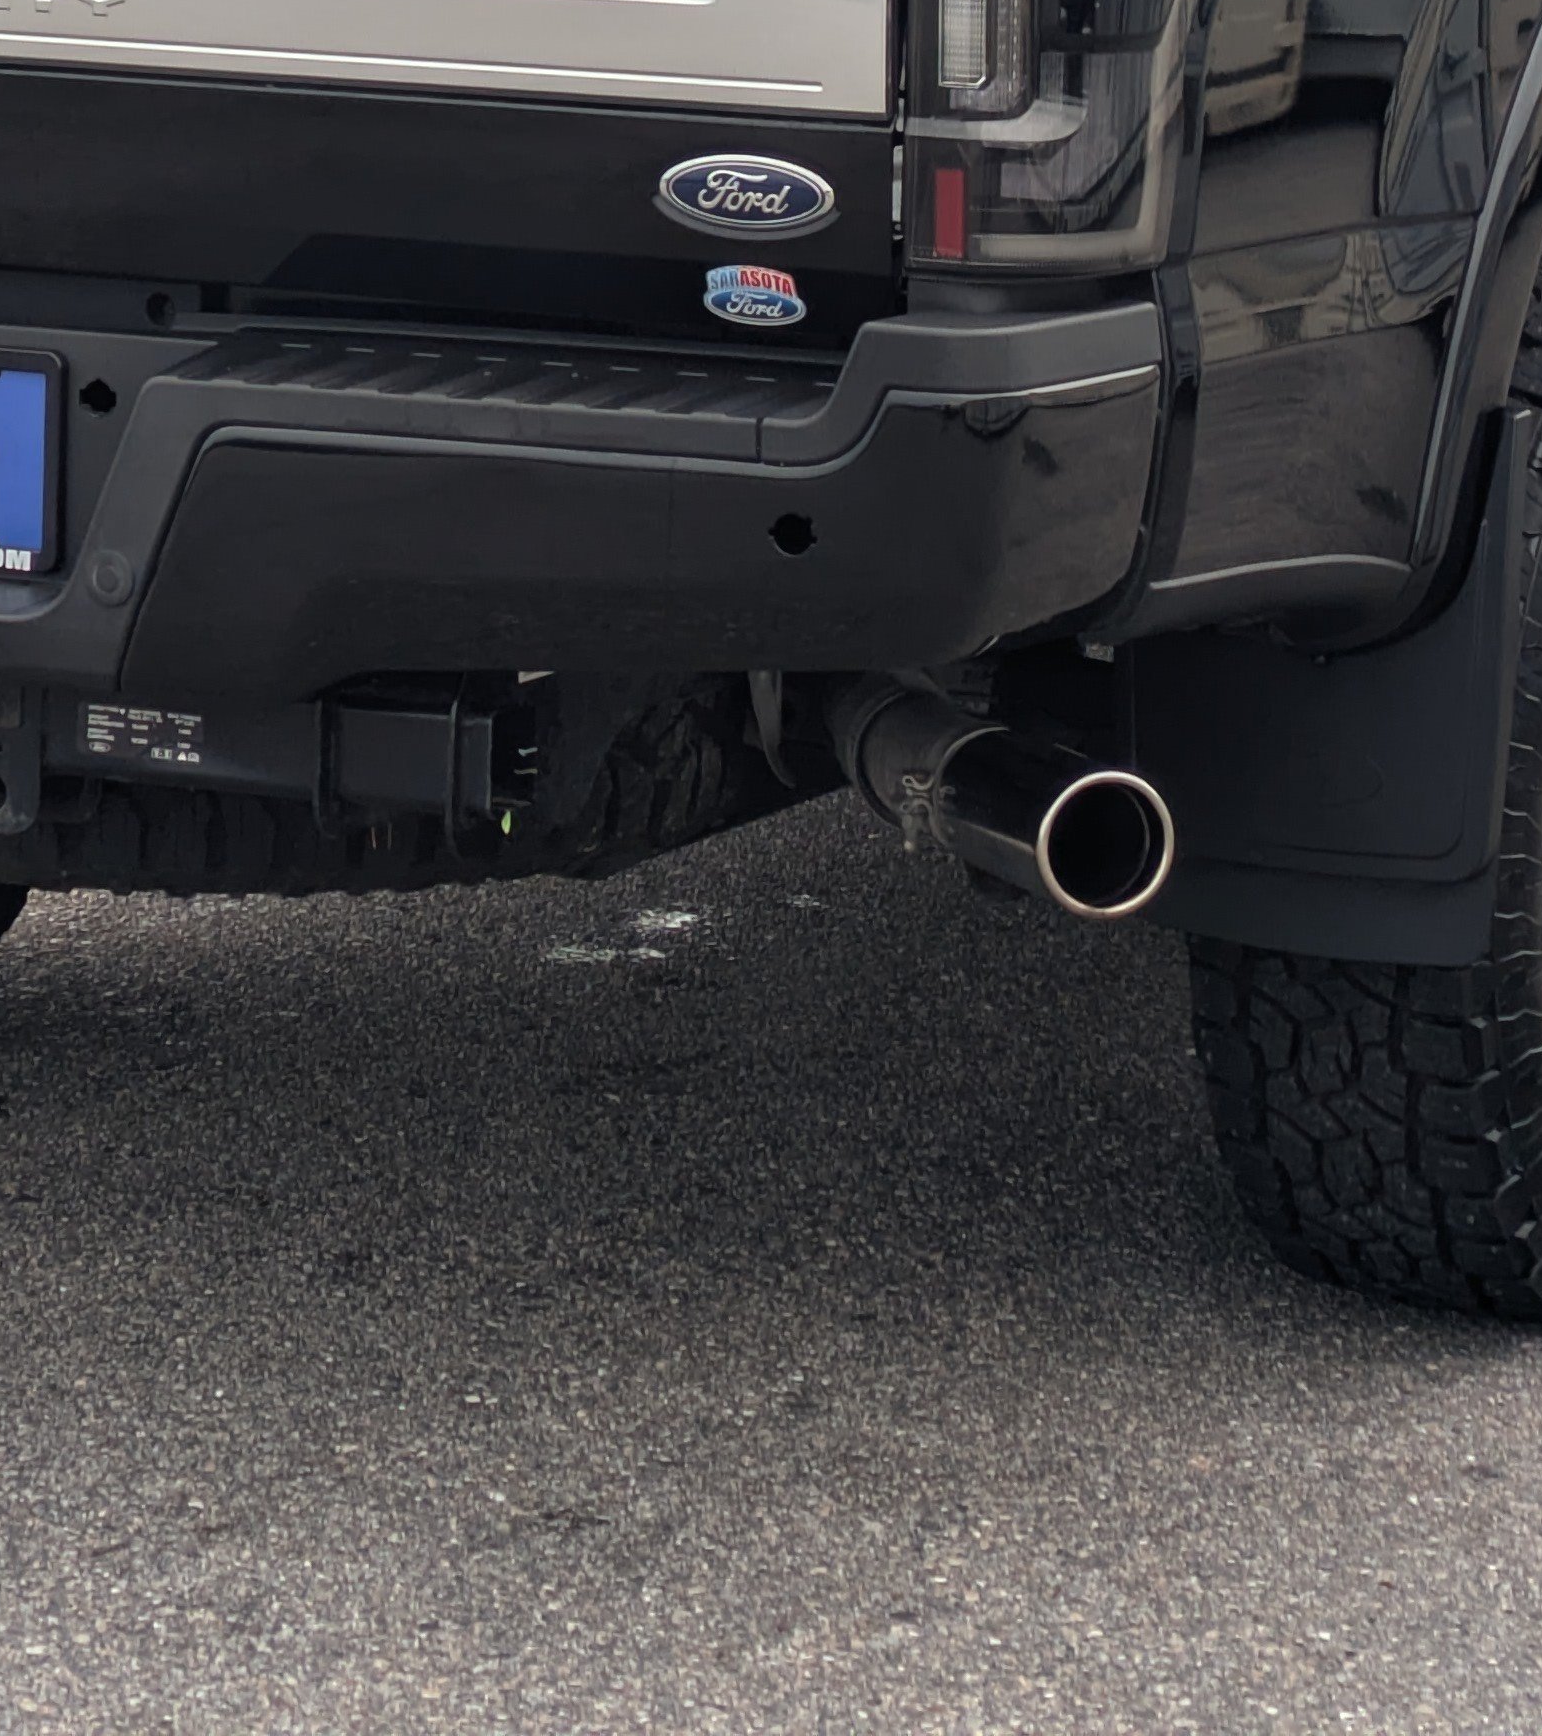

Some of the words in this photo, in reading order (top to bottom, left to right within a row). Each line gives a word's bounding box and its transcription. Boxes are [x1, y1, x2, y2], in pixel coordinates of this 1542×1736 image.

[698, 169, 792, 215] Ford
[710, 269, 794, 297] SARASOTA
[725, 290, 784, 318] Ford
